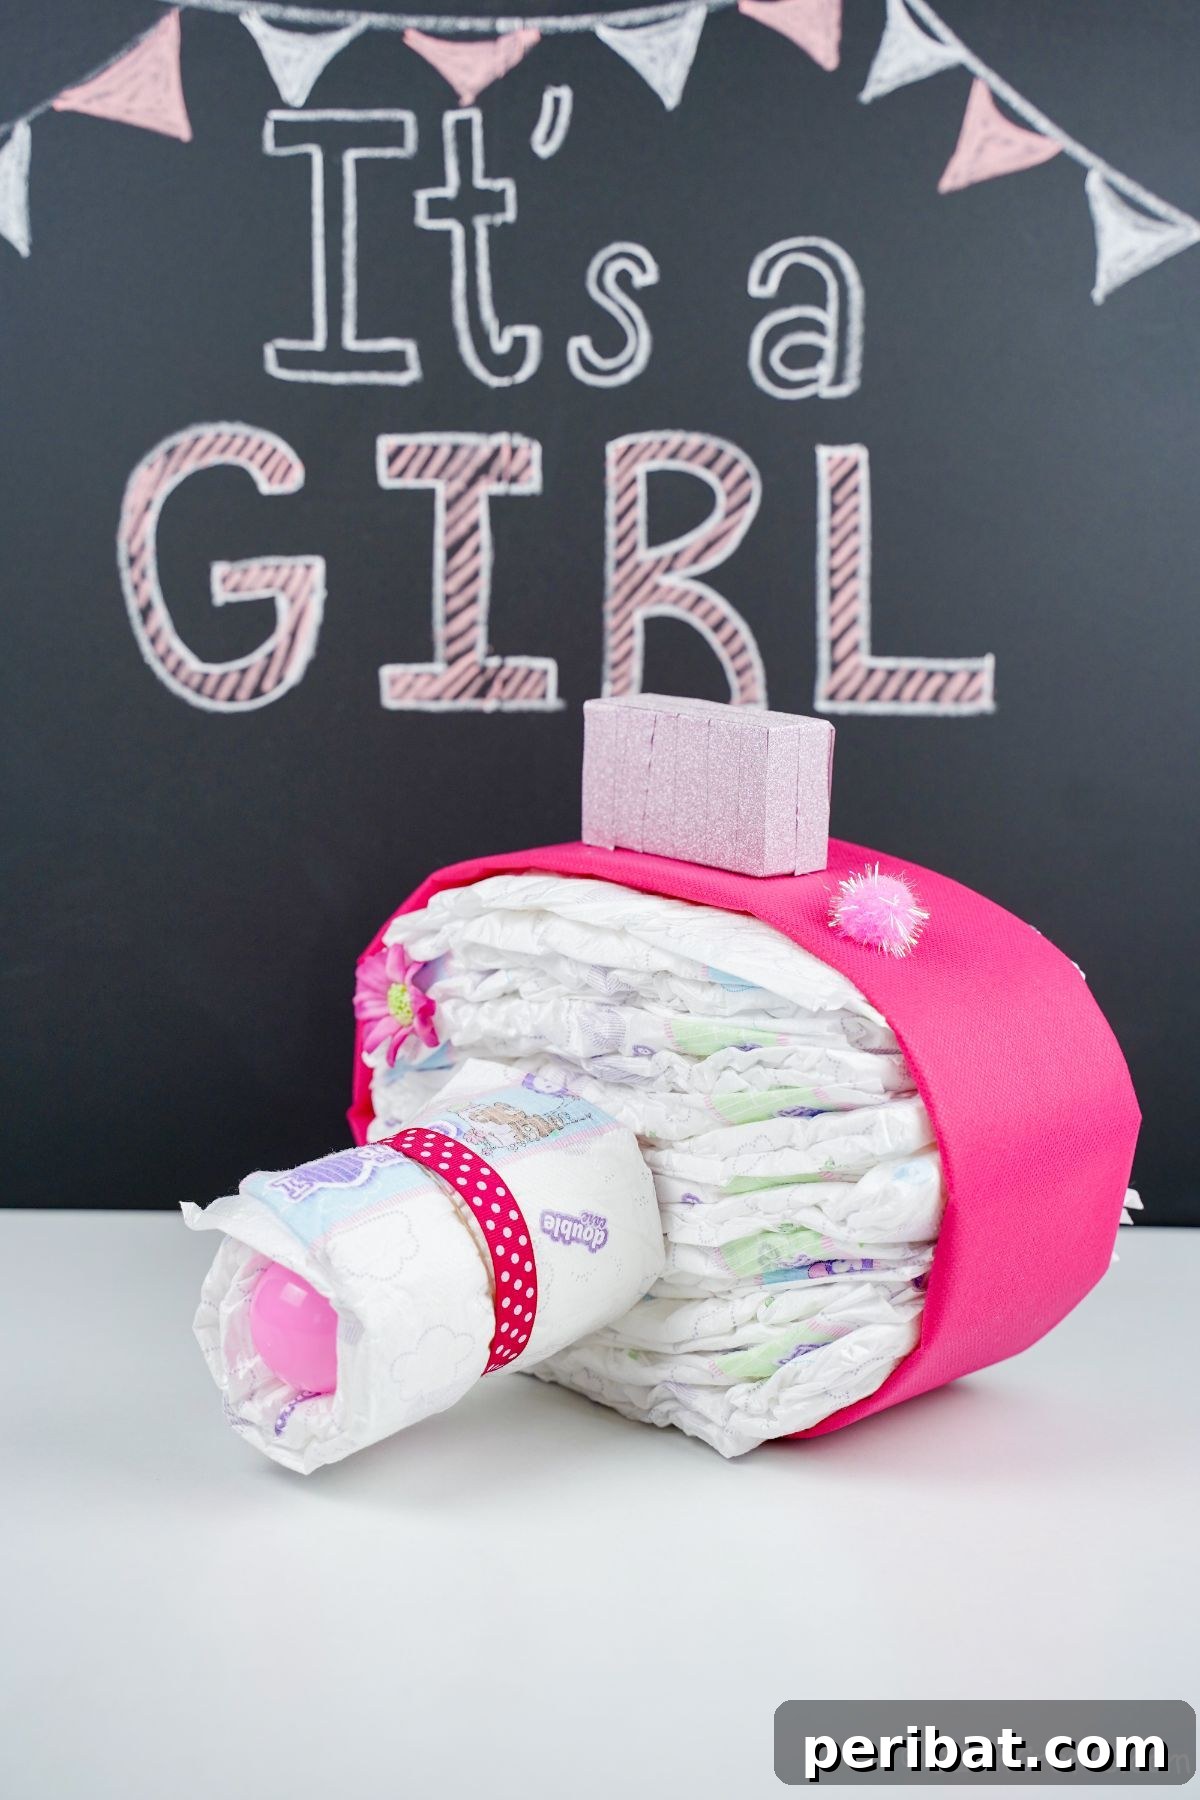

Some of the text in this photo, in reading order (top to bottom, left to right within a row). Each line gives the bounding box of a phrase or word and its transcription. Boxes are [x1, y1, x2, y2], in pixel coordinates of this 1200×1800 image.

[262, 84, 865, 400] It's a
[116, 421, 996, 715] GIRL
[542, 1213, 607, 1251] double
[580, 1212, 606, 1228] care
